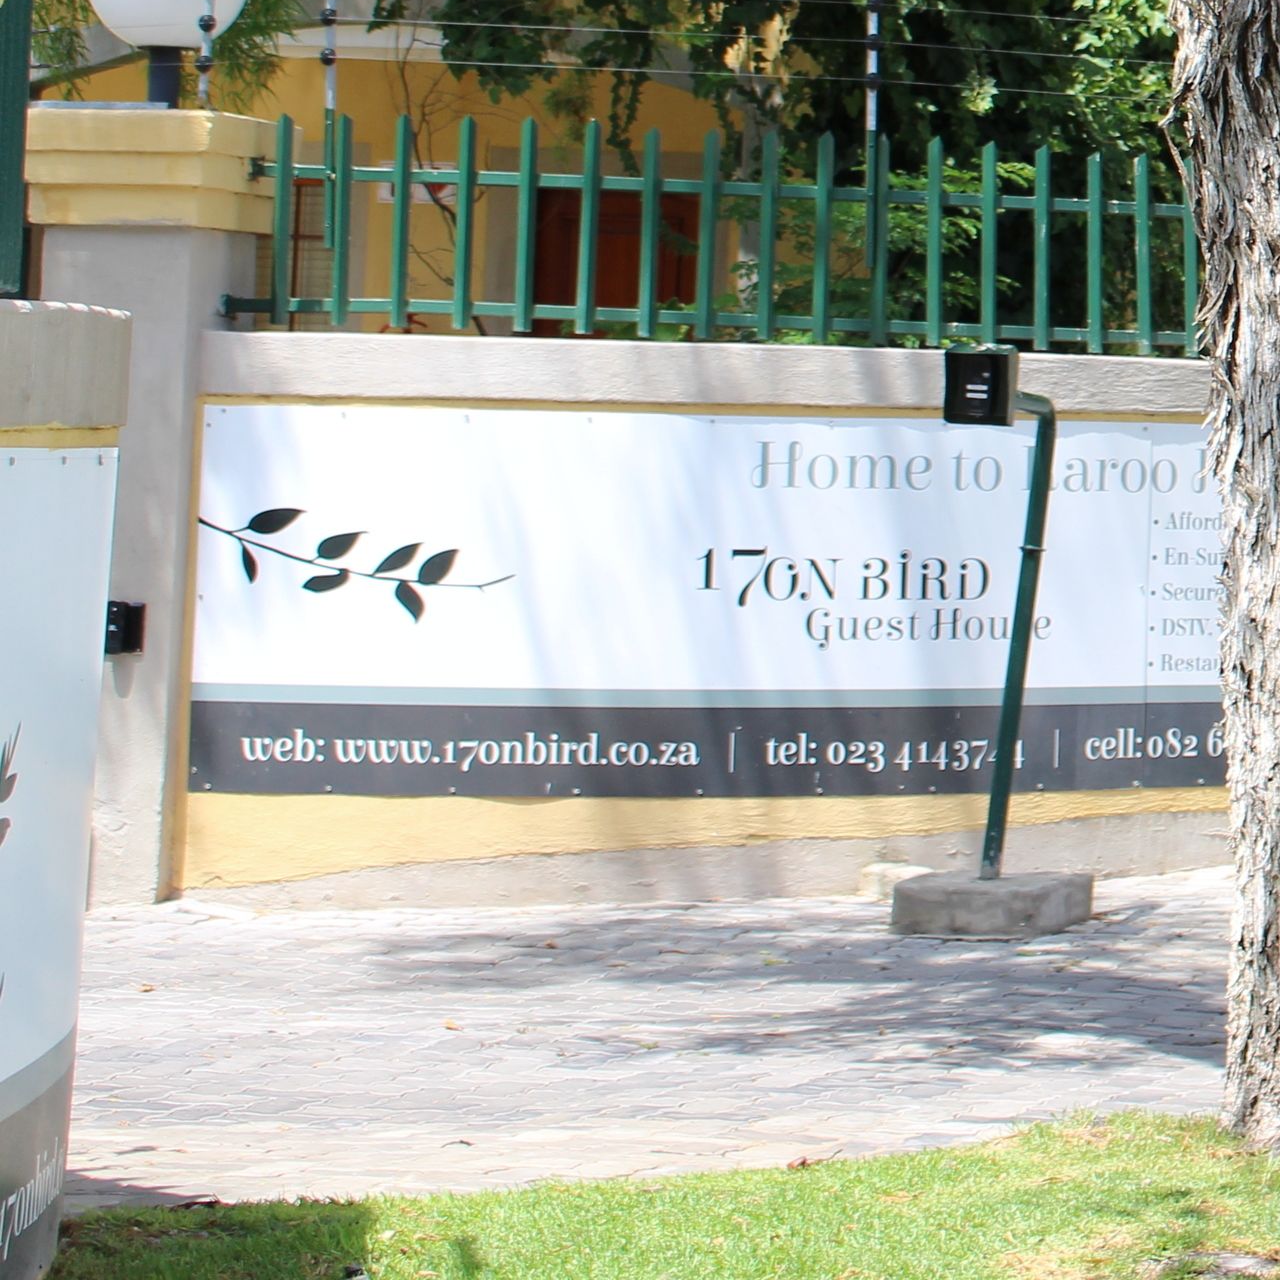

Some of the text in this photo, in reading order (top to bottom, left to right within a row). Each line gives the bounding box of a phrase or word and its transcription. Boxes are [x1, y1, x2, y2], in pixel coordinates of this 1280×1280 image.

[751, 441, 933, 491] Home
[951, 449, 1003, 492] to
[806, 607, 1052, 650] Guest Houe
[241, 728, 326, 762] web:
[334, 731, 700, 773] www.17onbird.co.za
[766, 732, 818, 766] tel:
[825, 740, 885, 773] 023
[894, 739, 1025, 771] 414374
[1147, 726, 1198, 759] 082
